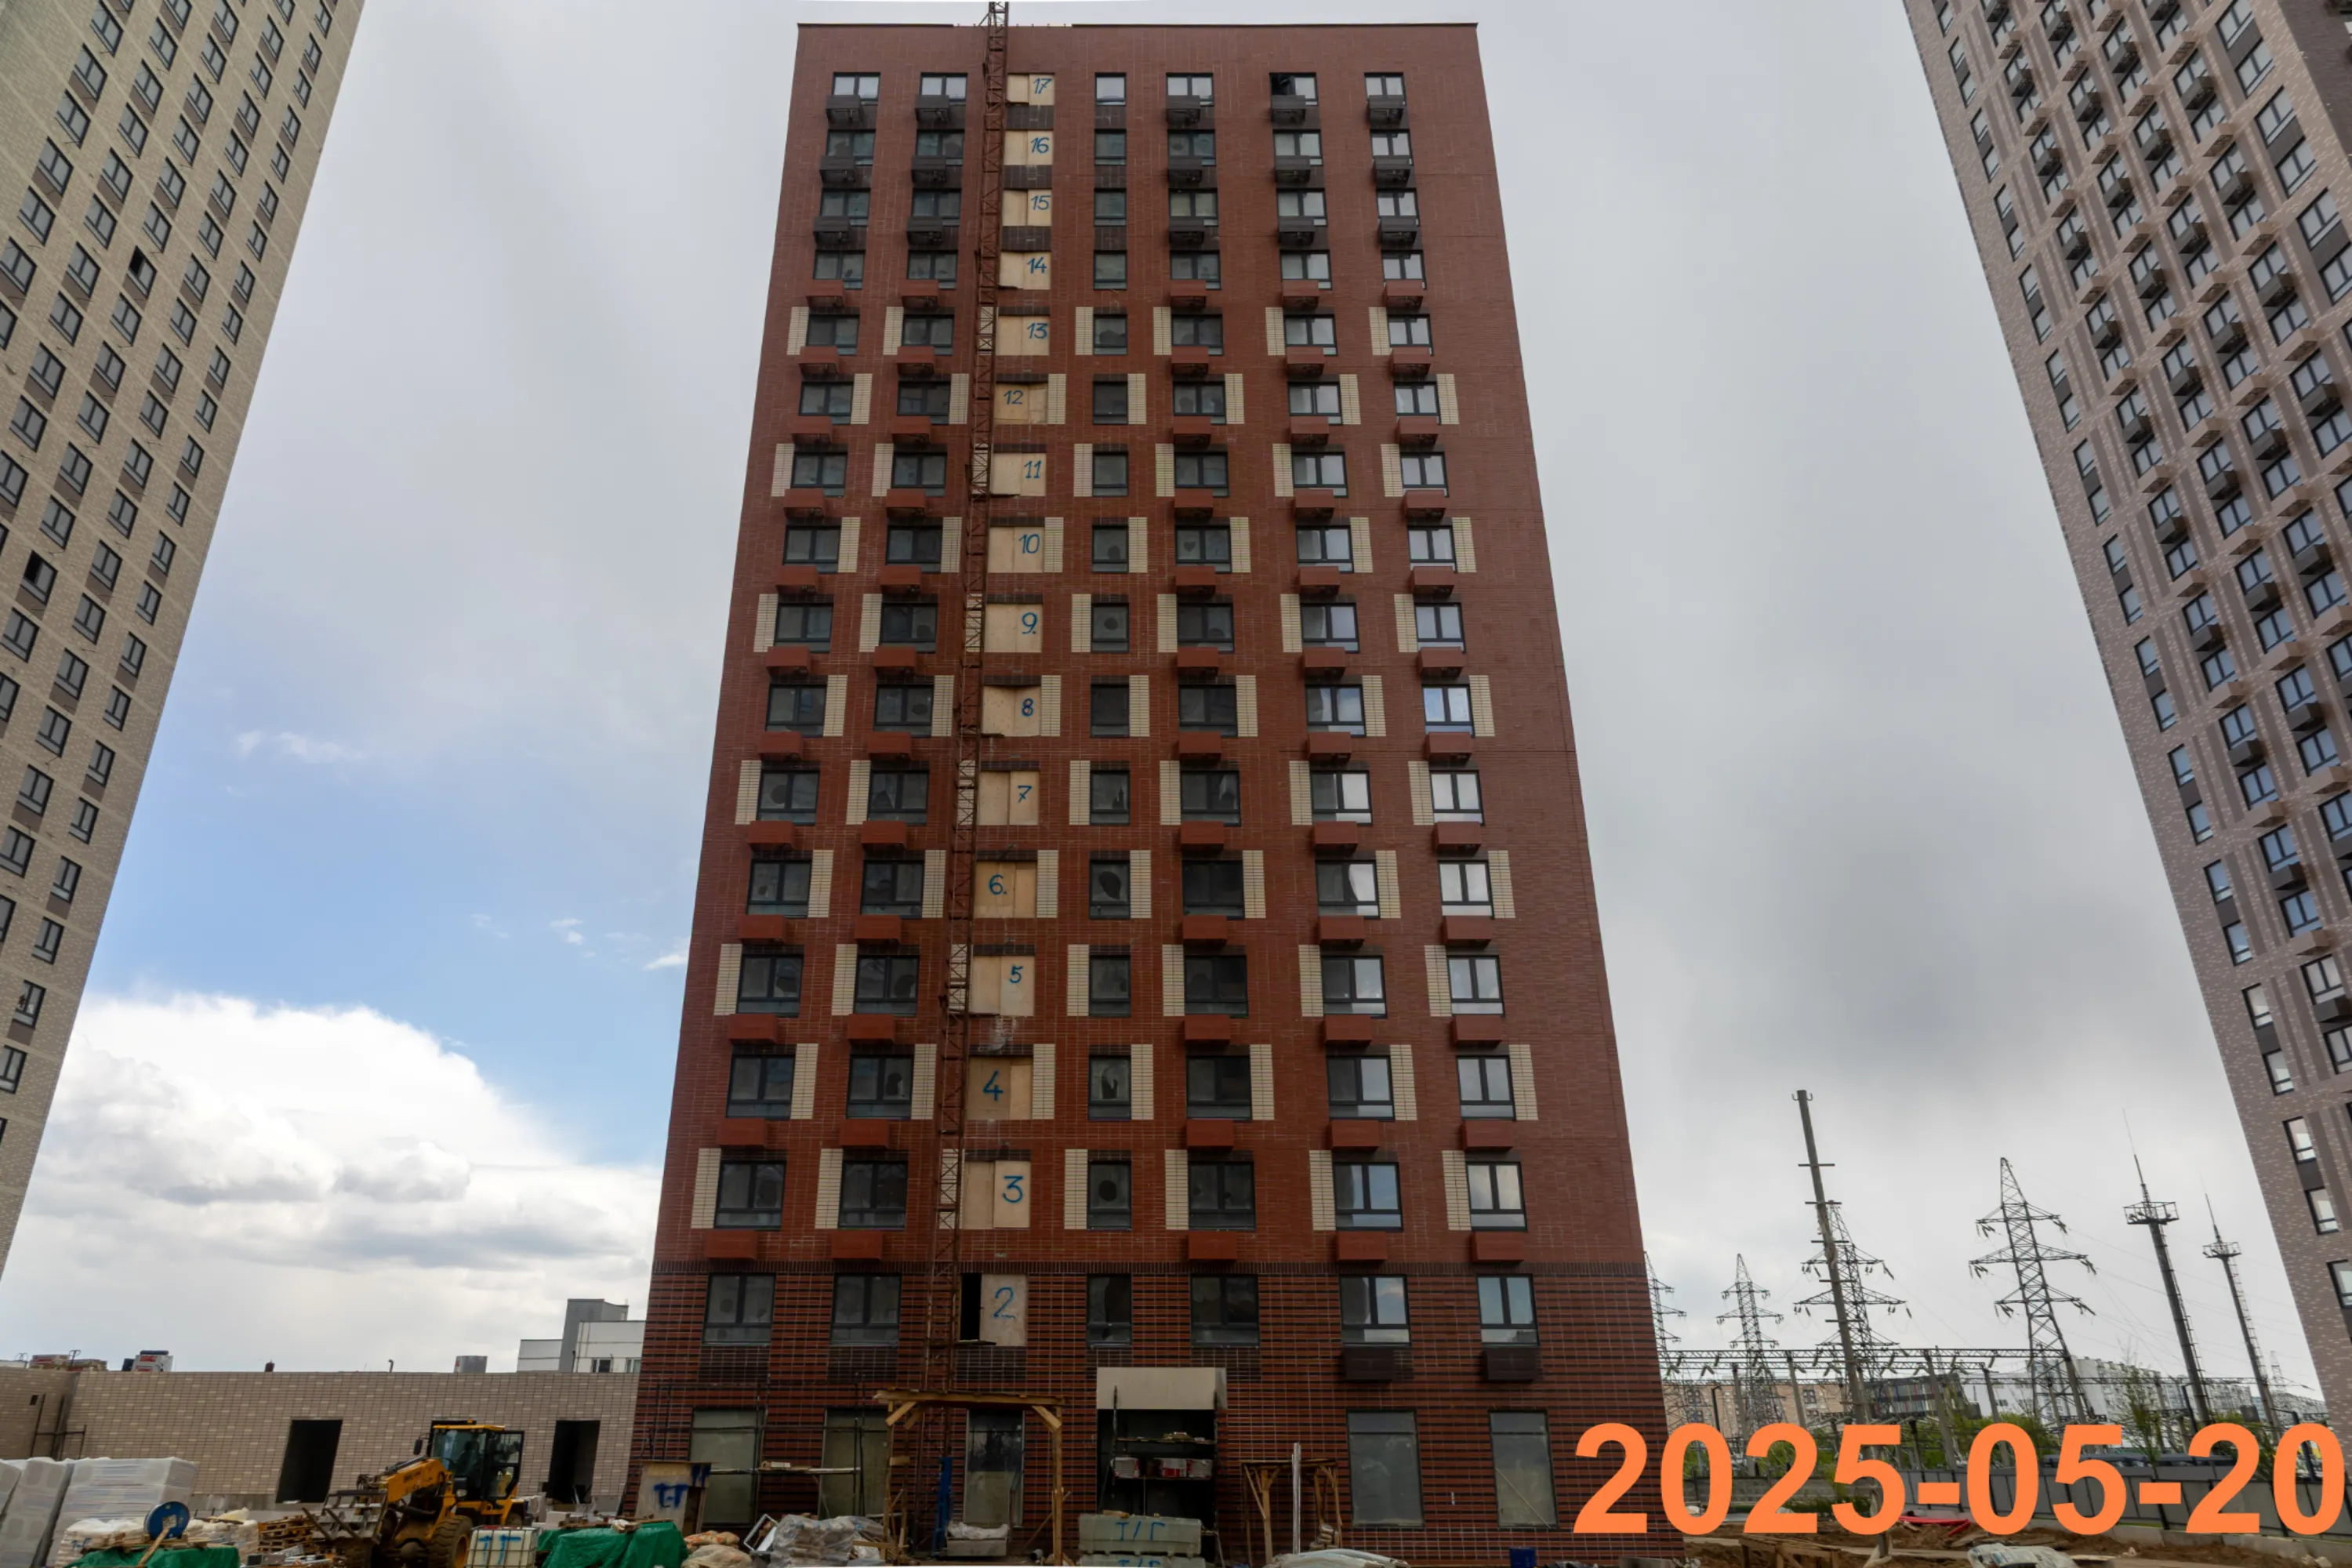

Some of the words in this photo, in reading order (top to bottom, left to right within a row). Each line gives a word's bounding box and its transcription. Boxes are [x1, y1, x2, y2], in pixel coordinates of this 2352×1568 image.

[1033, 78, 1052, 94] 17
[1030, 137, 1051, 154] 16
[1031, 195, 1051, 210] 15
[1027, 257, 1047, 274] 14
[1027, 322, 1048, 339] 13
[1004, 390, 1024, 405] 12
[1024, 460, 1043, 479] 11
[1018, 534, 1040, 554] 10
[1022, 698, 1034, 717] 8
[1018, 785, 1033, 803] 7
[1009, 965, 1023, 984] 5
[982, 1069, 1004, 1102] 4
[1002, 1175, 1024, 1203] 3
[994, 1287, 1017, 1319] 2
